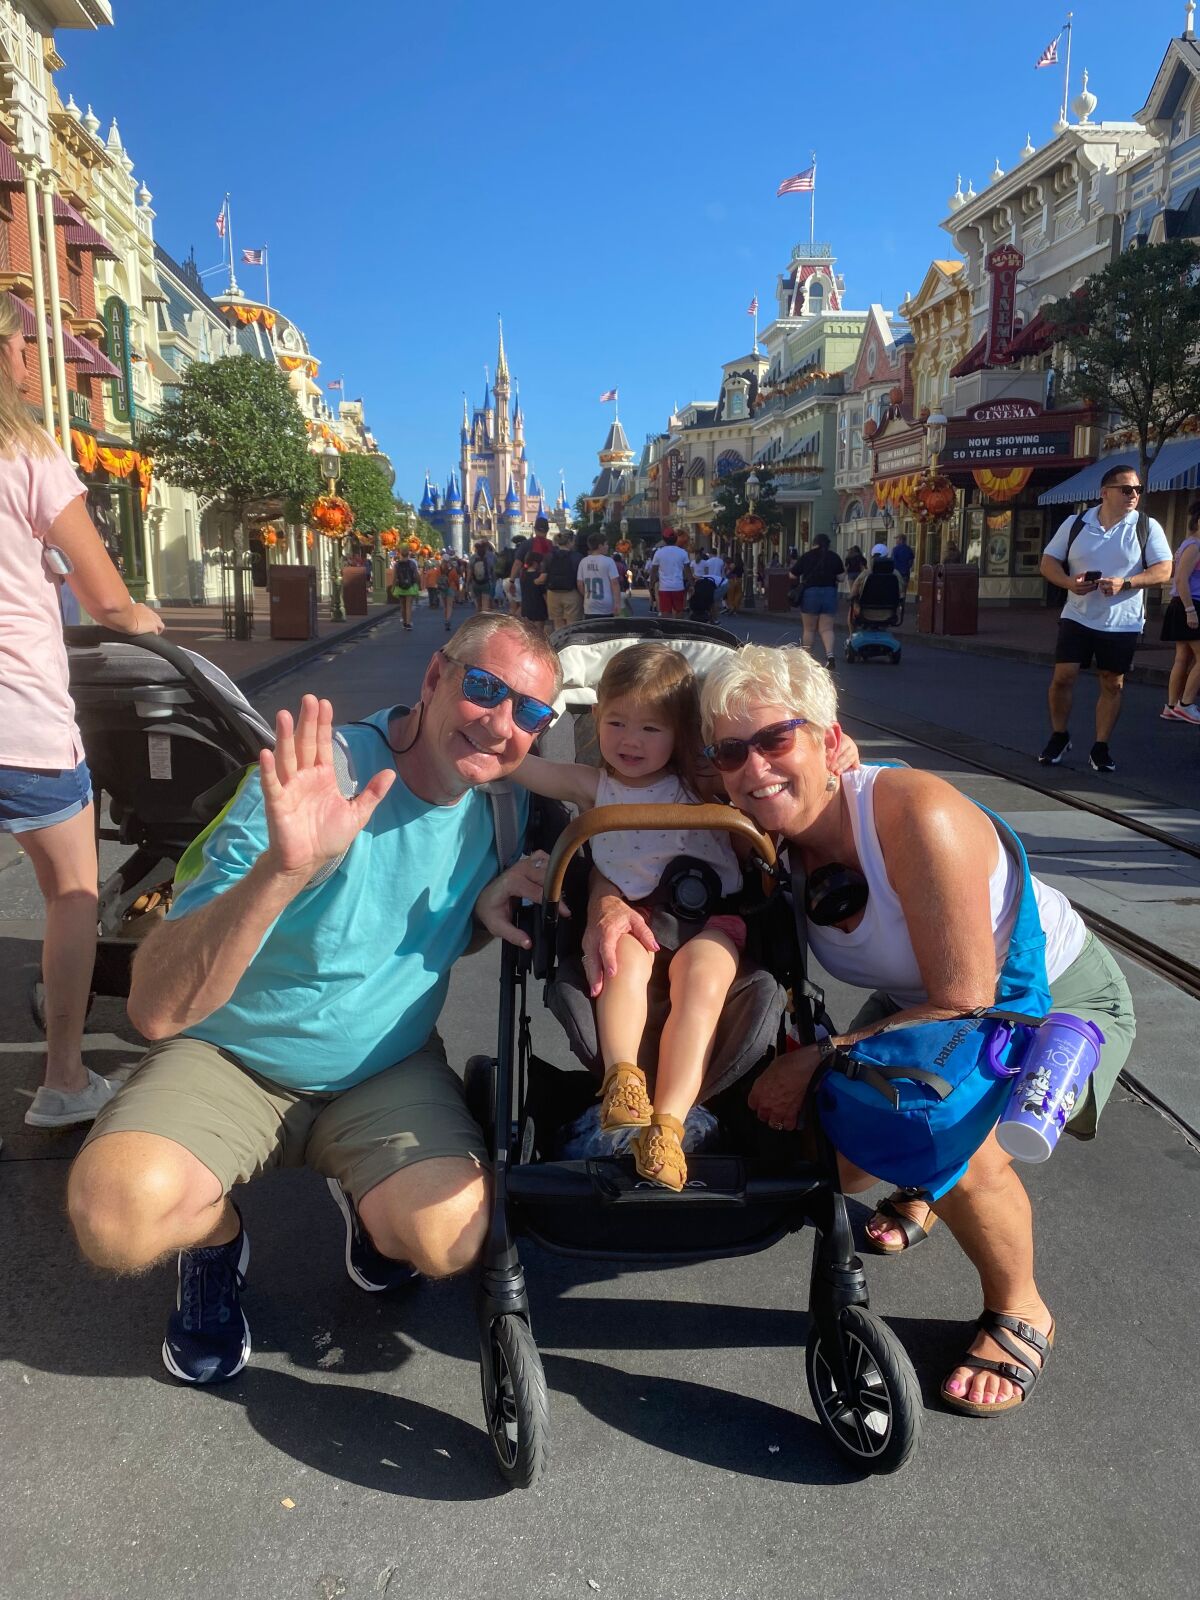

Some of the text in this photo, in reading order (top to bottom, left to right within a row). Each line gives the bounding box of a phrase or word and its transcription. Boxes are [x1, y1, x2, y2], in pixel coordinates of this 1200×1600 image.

[992, 254, 1019, 265] MAIN
[996, 270, 1014, 352] CINEMA
[973, 406, 1036, 421] CINEMA
[990, 404, 1010, 412] MAIN
[968, 435, 1040, 447] NOW SHOWING
[953, 446, 1056, 459] 50 YEARS OF MAGIC
[584, 577, 604, 600] 10
